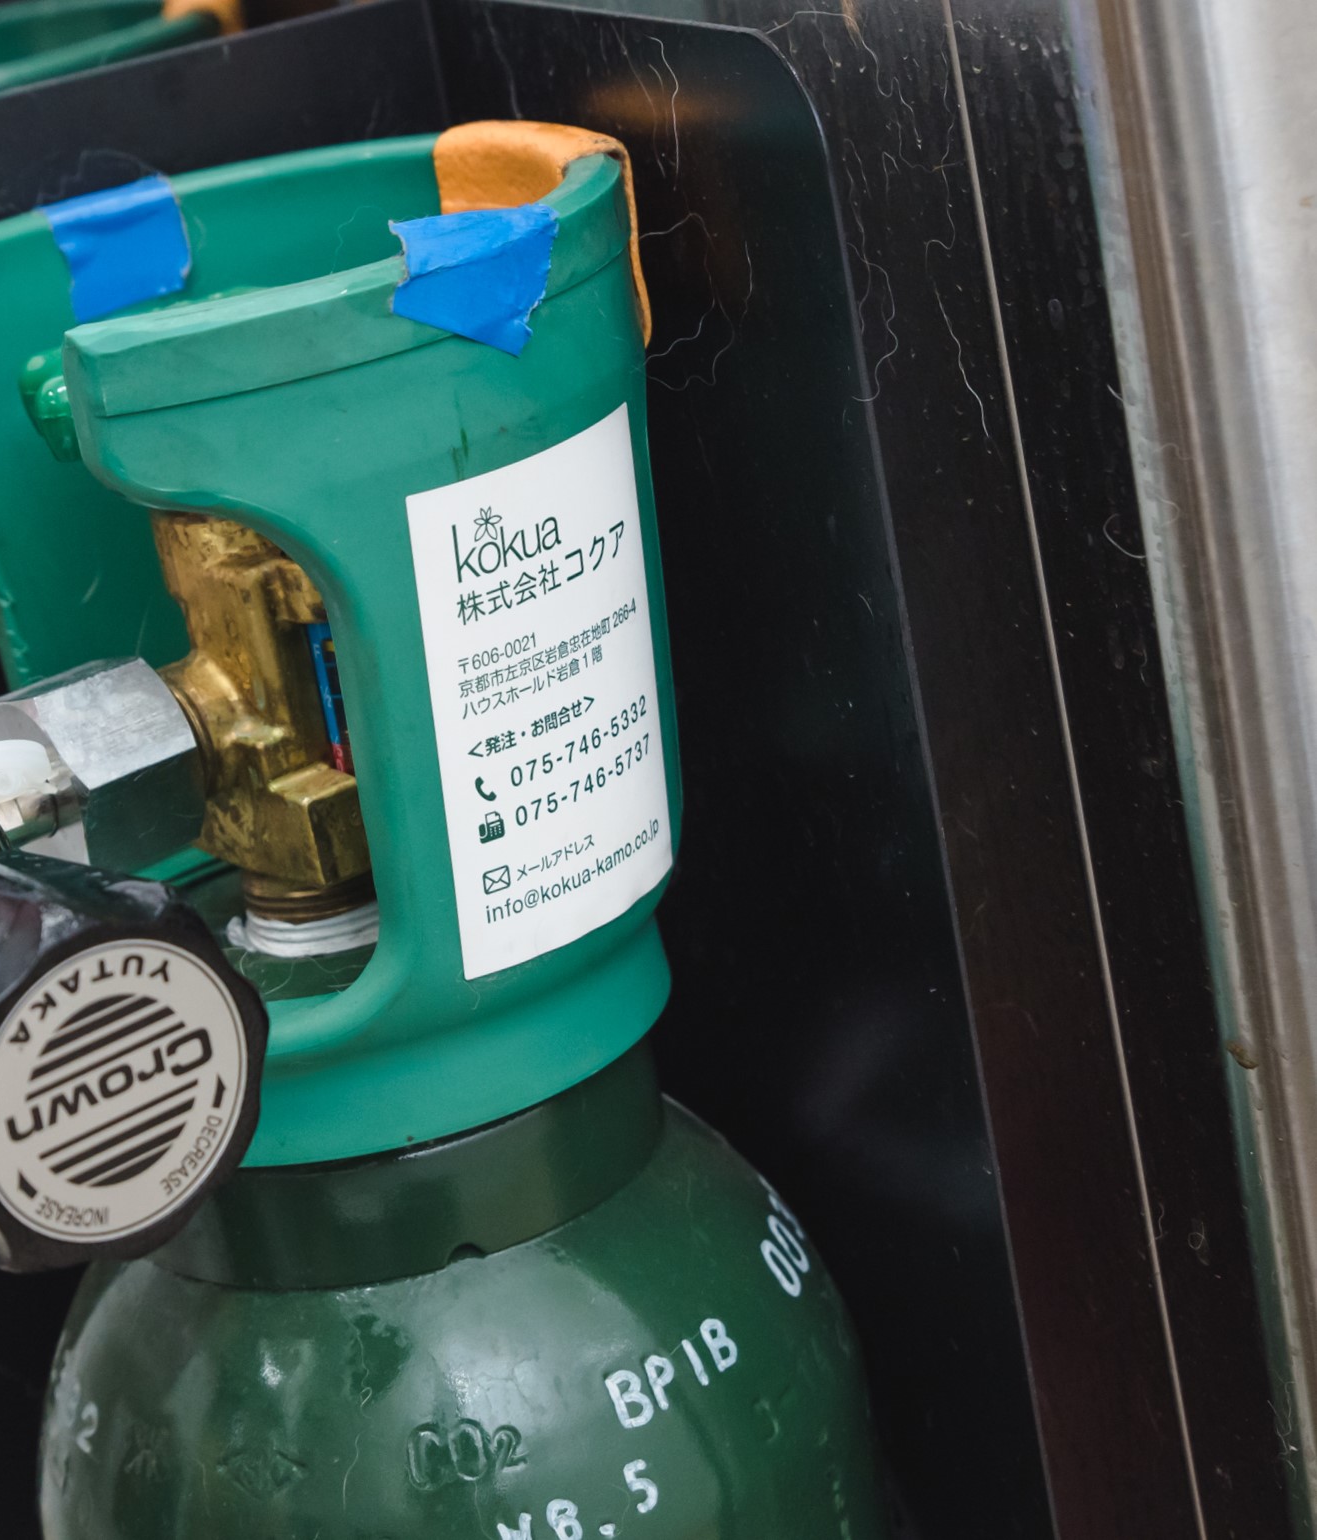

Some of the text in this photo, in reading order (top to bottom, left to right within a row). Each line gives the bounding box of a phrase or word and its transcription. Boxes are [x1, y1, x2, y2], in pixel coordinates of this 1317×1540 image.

[452, 516, 562, 583] kokua
[457, 520, 624, 626] 株式会社コクア
[510, 694, 647, 787] 075-746-5332
[515, 733, 650, 826] 075-746-5737
[485, 817, 660, 924] info@kokua-kamo.co.jp
[516, 834, 595, 882] メールアドレス
[8, 955, 170, 1045] YUTAKA
[5, 1027, 213, 1142] Crown
[159, 1114, 223, 1196] DECREASE
[35, 1195, 109, 1228] INCREASE
